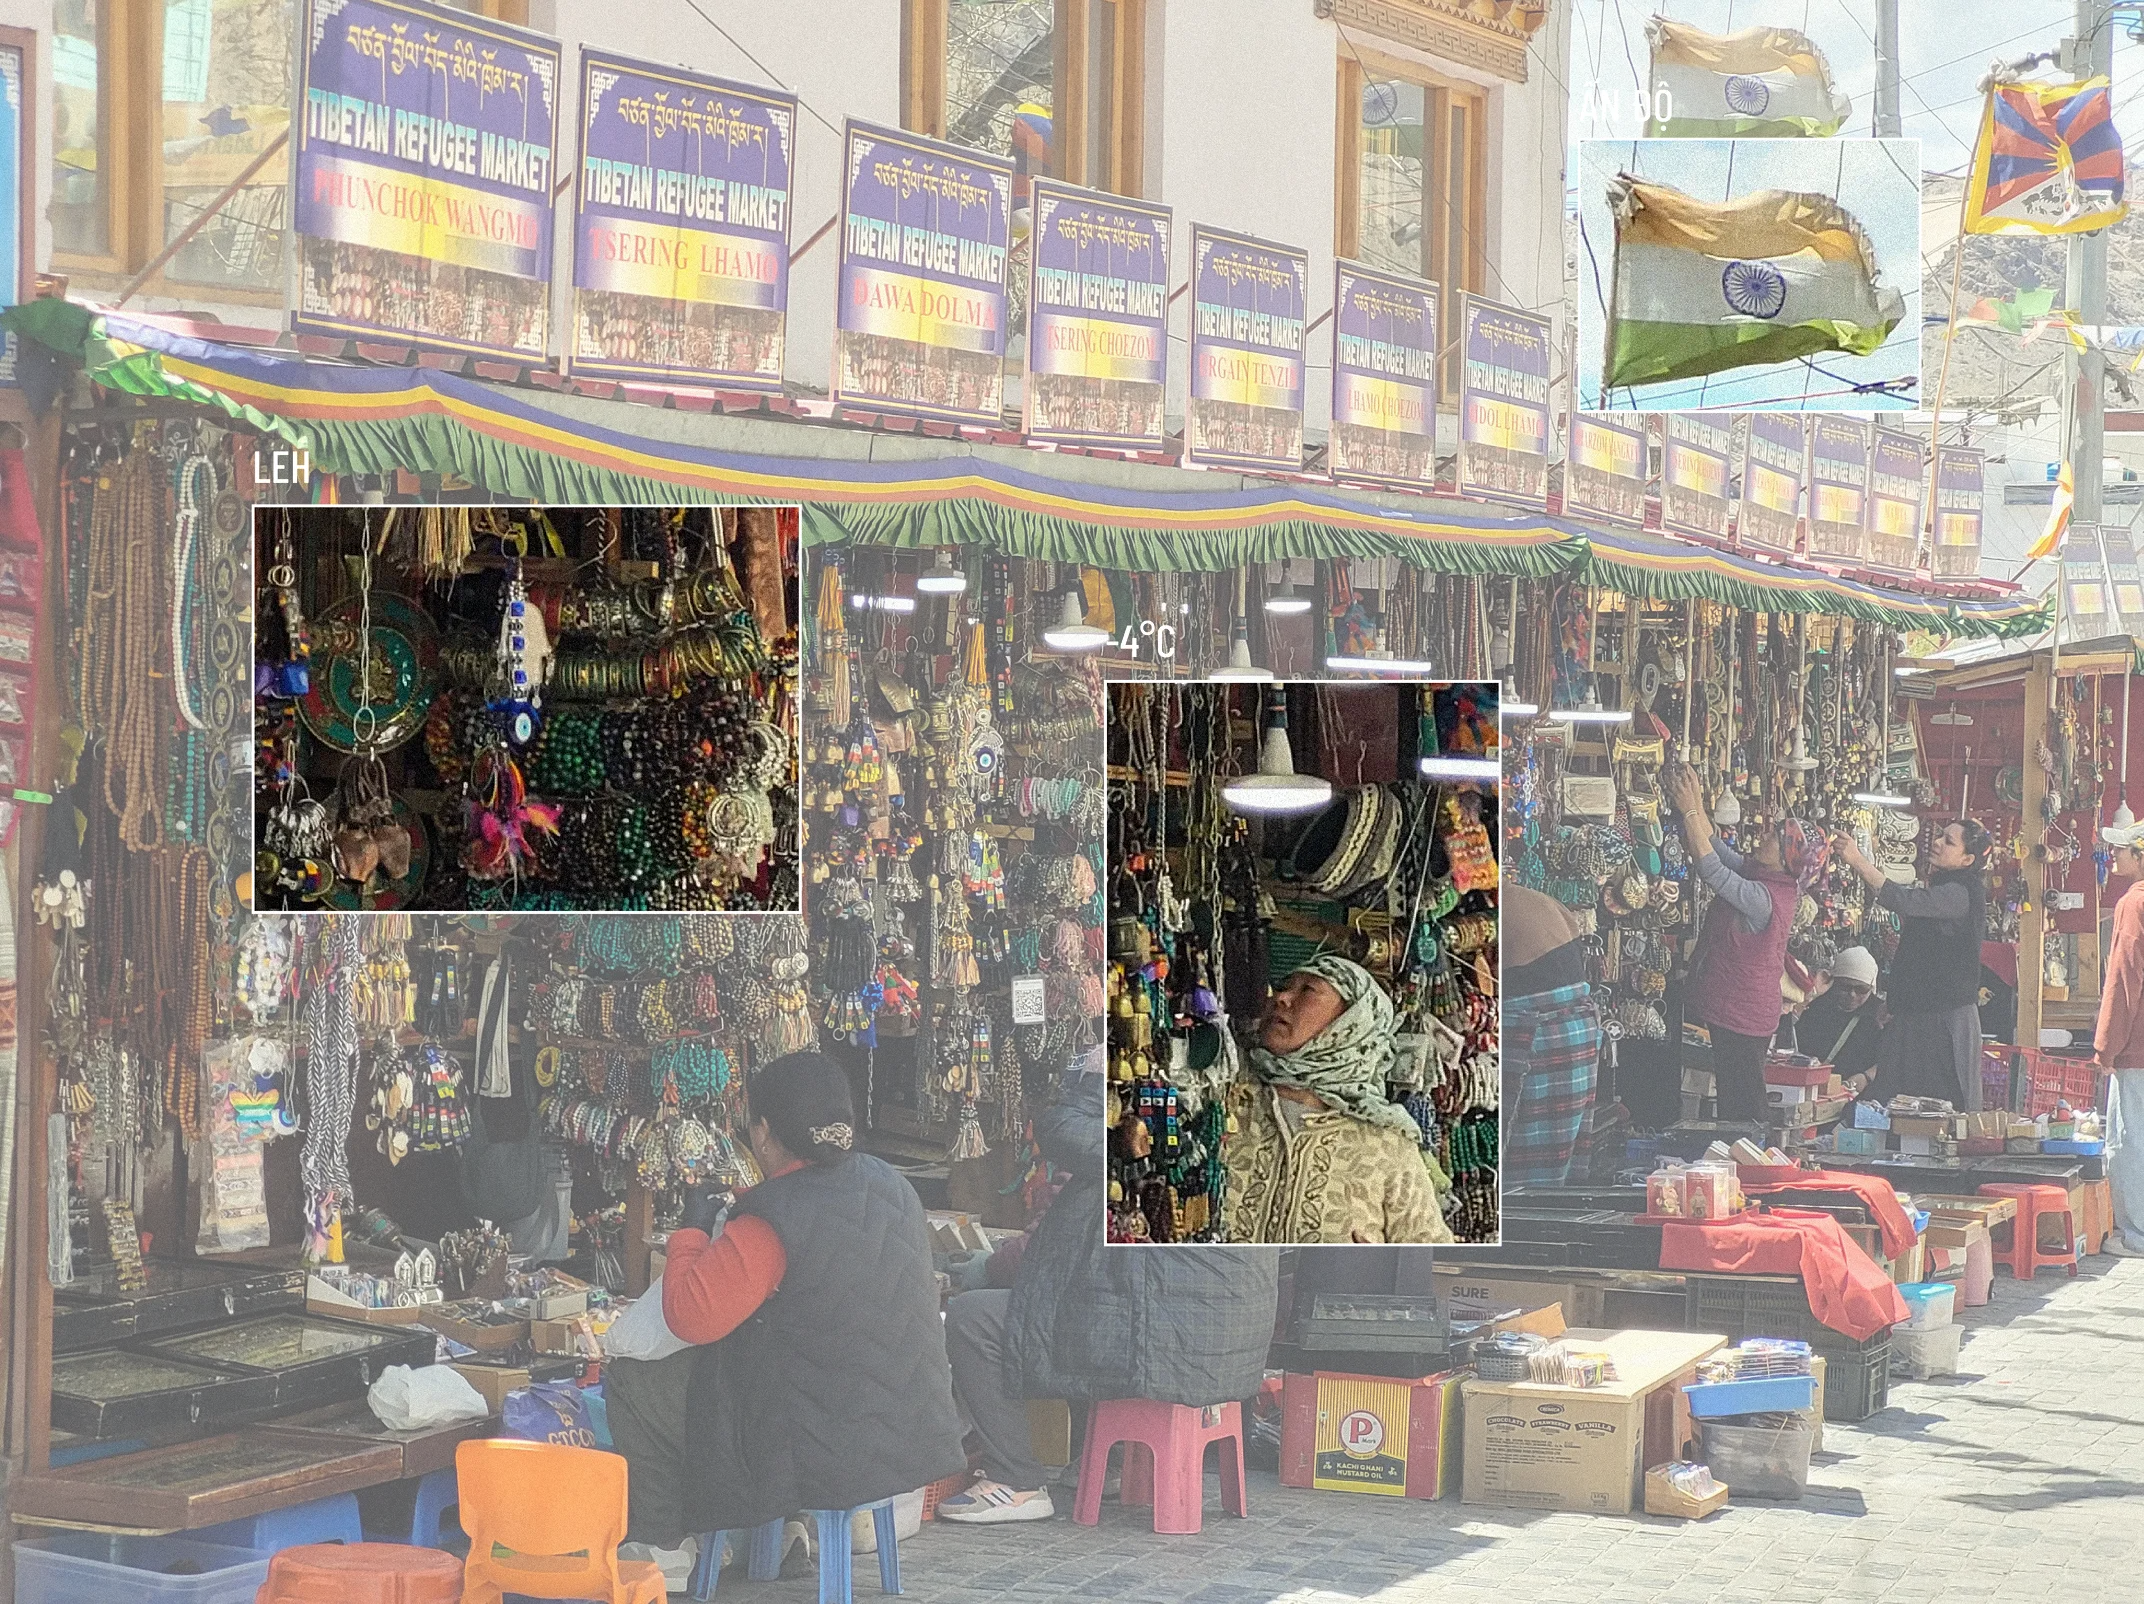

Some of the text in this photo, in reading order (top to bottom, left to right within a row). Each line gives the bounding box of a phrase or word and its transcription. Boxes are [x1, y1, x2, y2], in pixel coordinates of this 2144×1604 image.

[308, 87, 390, 155] TIBETAN
[394, 108, 477, 176] REFUGEE
[480, 131, 551, 193] MARKET
[314, 168, 538, 248] PHUNCHOK WANGMO
[586, 156, 787, 232] TIBETAN REFUGEE MARKET
[589, 227, 778, 285] TSERING LHAMO
[849, 213, 1005, 284] TIBETAN REFUGEE MARKET
[854, 277, 995, 329] DAWA DOLMA
[1037, 267, 1166, 319] TIBETAN REFUGEE MARKET
[1046, 325, 1096, 354] TSERING
[1196, 301, 1304, 351] TIBETAN REFUGEE MARKET
[1339, 332, 1434, 380] TIBETAN REFUGEE MARKET
[1252, 362, 1297, 389] TENZI
[1451, 1286, 1490, 1300] SURE
[1349, 1417, 1373, 1443] P
[1487, 1417, 1525, 1427] CHOCOLATE
[1531, 1420, 1569, 1430] STRAWBERRY
[1578, 1423, 1613, 1432] VANILLA
[1336, 1462, 1384, 1473] KACHI GHANI
[1336, 1469, 1383, 1480] MUSTARD OIL
